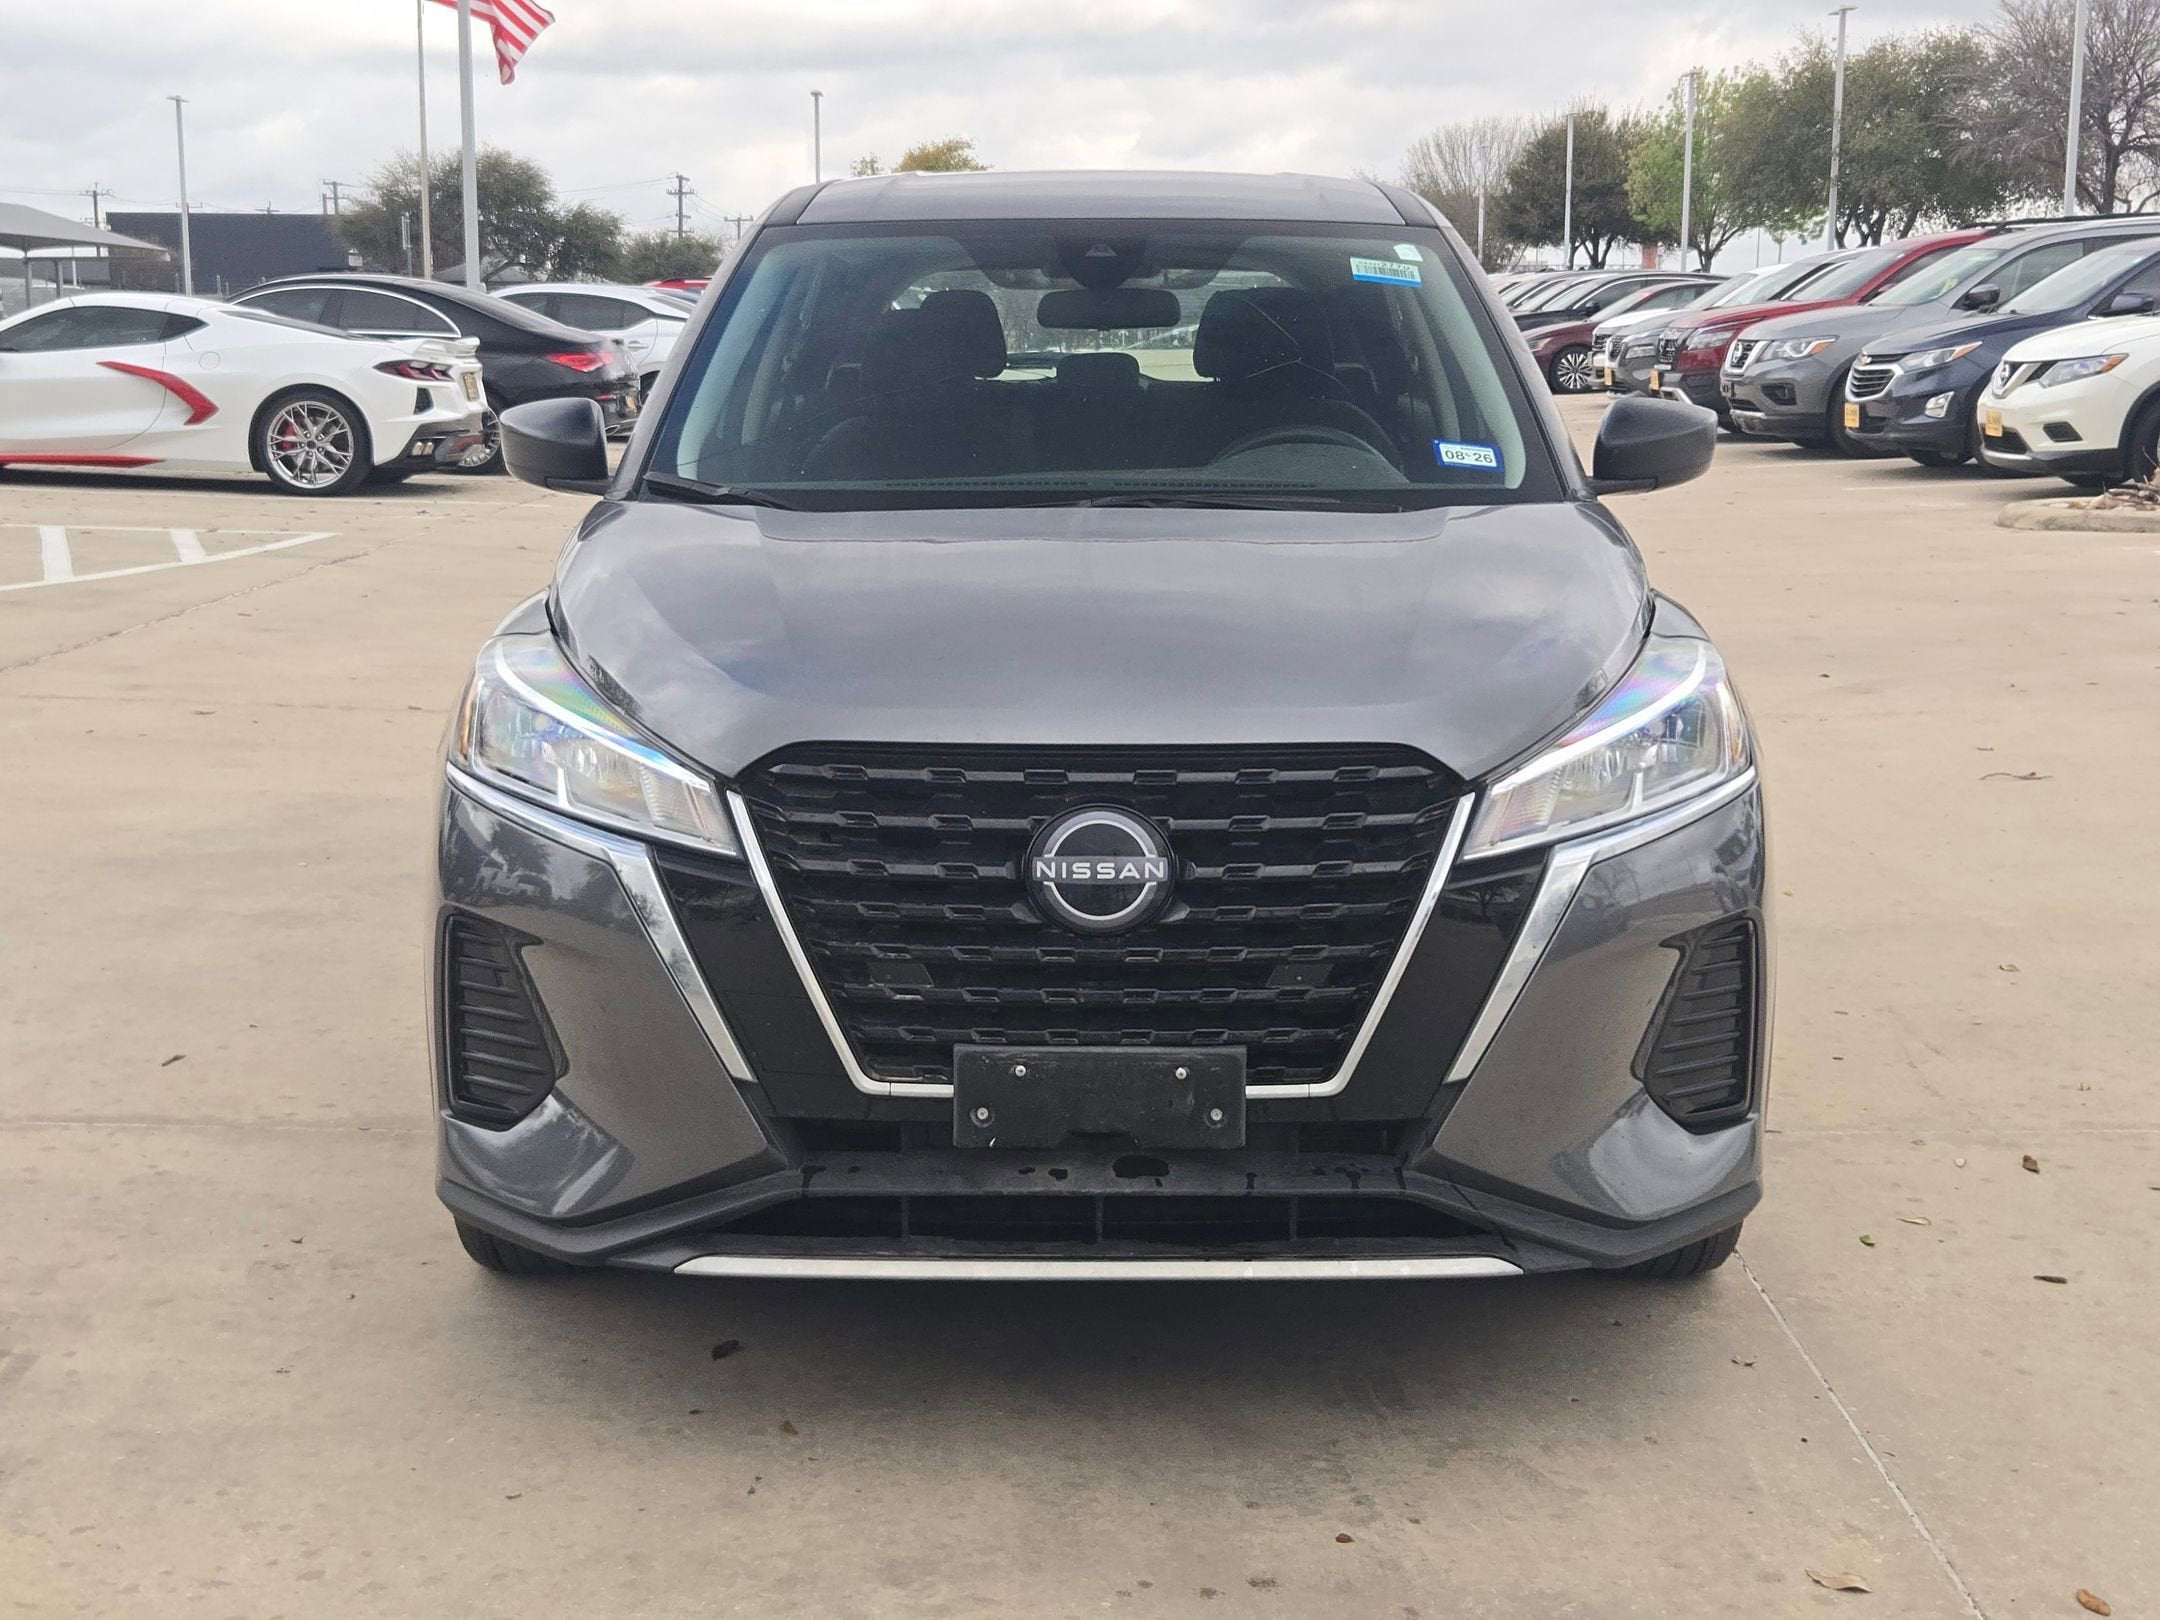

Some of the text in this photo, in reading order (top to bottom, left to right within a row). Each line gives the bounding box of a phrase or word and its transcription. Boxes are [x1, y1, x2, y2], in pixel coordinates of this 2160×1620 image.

[1445, 449, 1465, 461] 08
[1472, 452, 1493, 464] 26
[1036, 861, 1164, 879] NISSAN
